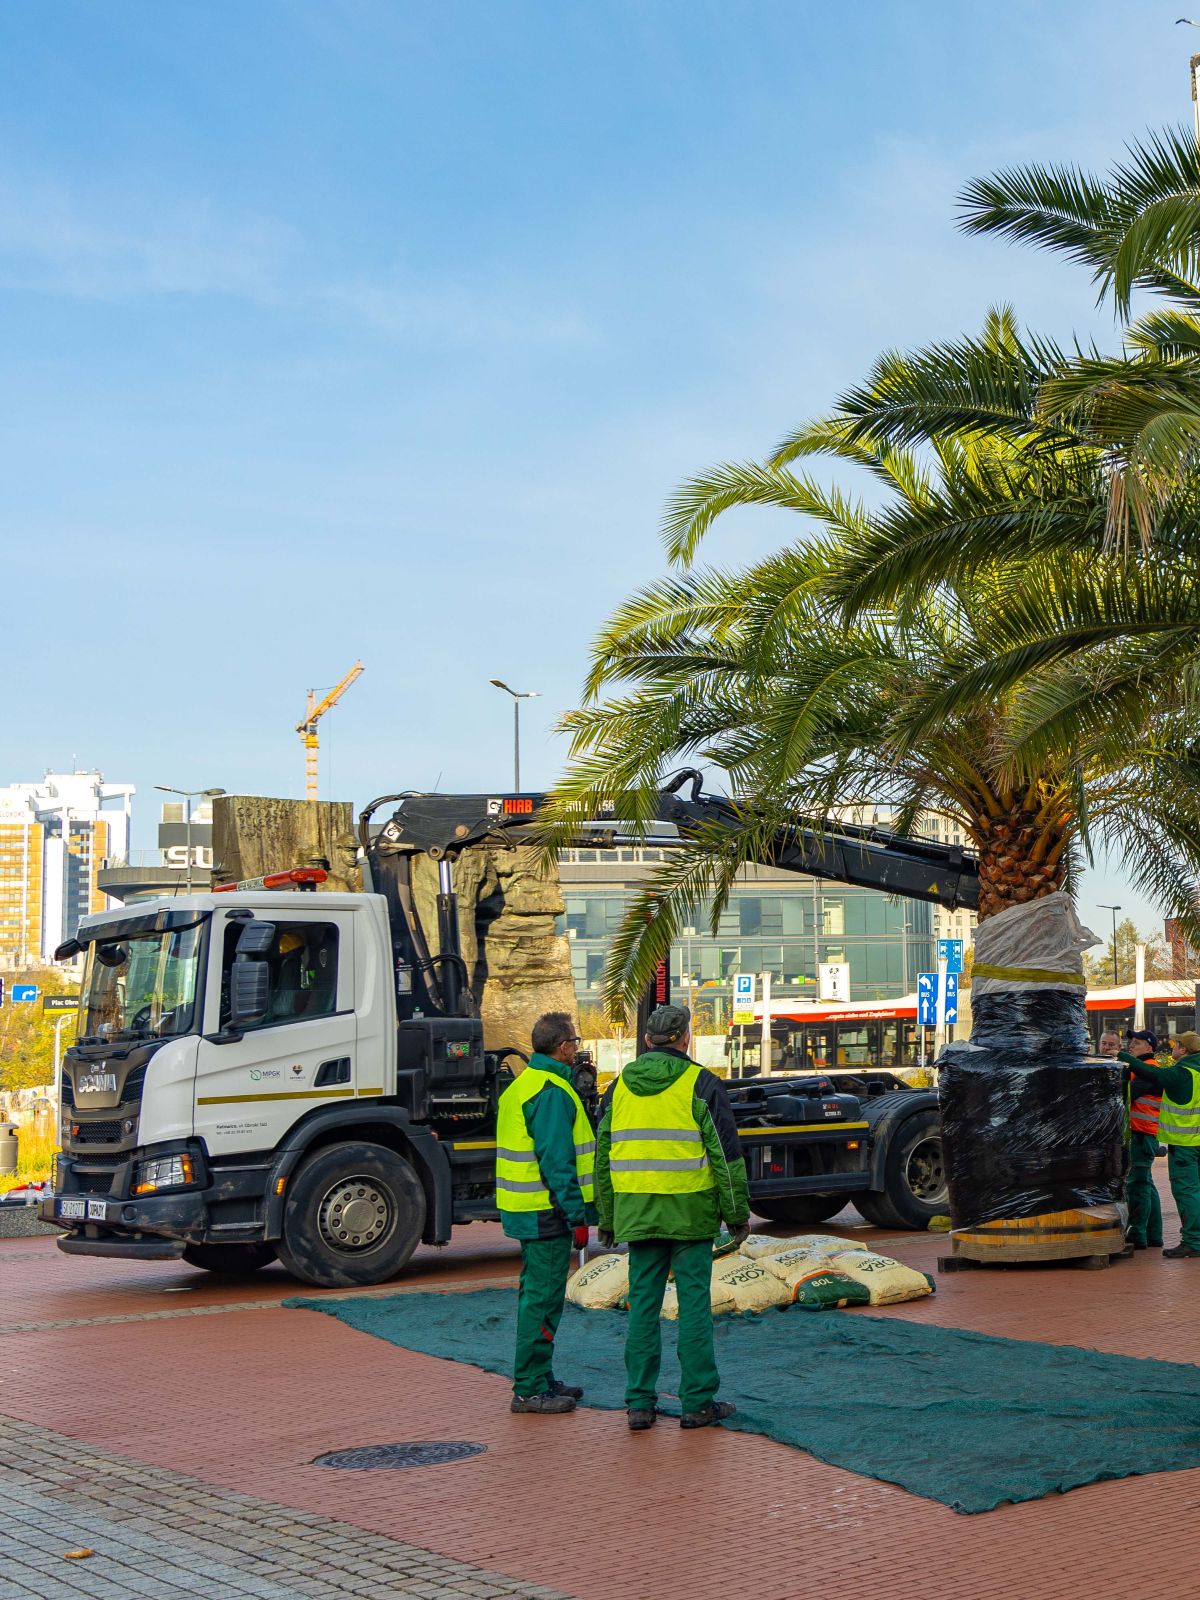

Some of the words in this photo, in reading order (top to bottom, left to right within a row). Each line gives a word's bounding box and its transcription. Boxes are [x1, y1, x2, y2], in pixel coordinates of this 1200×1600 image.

[504, 799, 533, 814] HIAB
[79, 1074, 117, 1092] SCANIA
[861, 1258, 896, 1273] ORA
[811, 1278, 833, 1288] 80L
